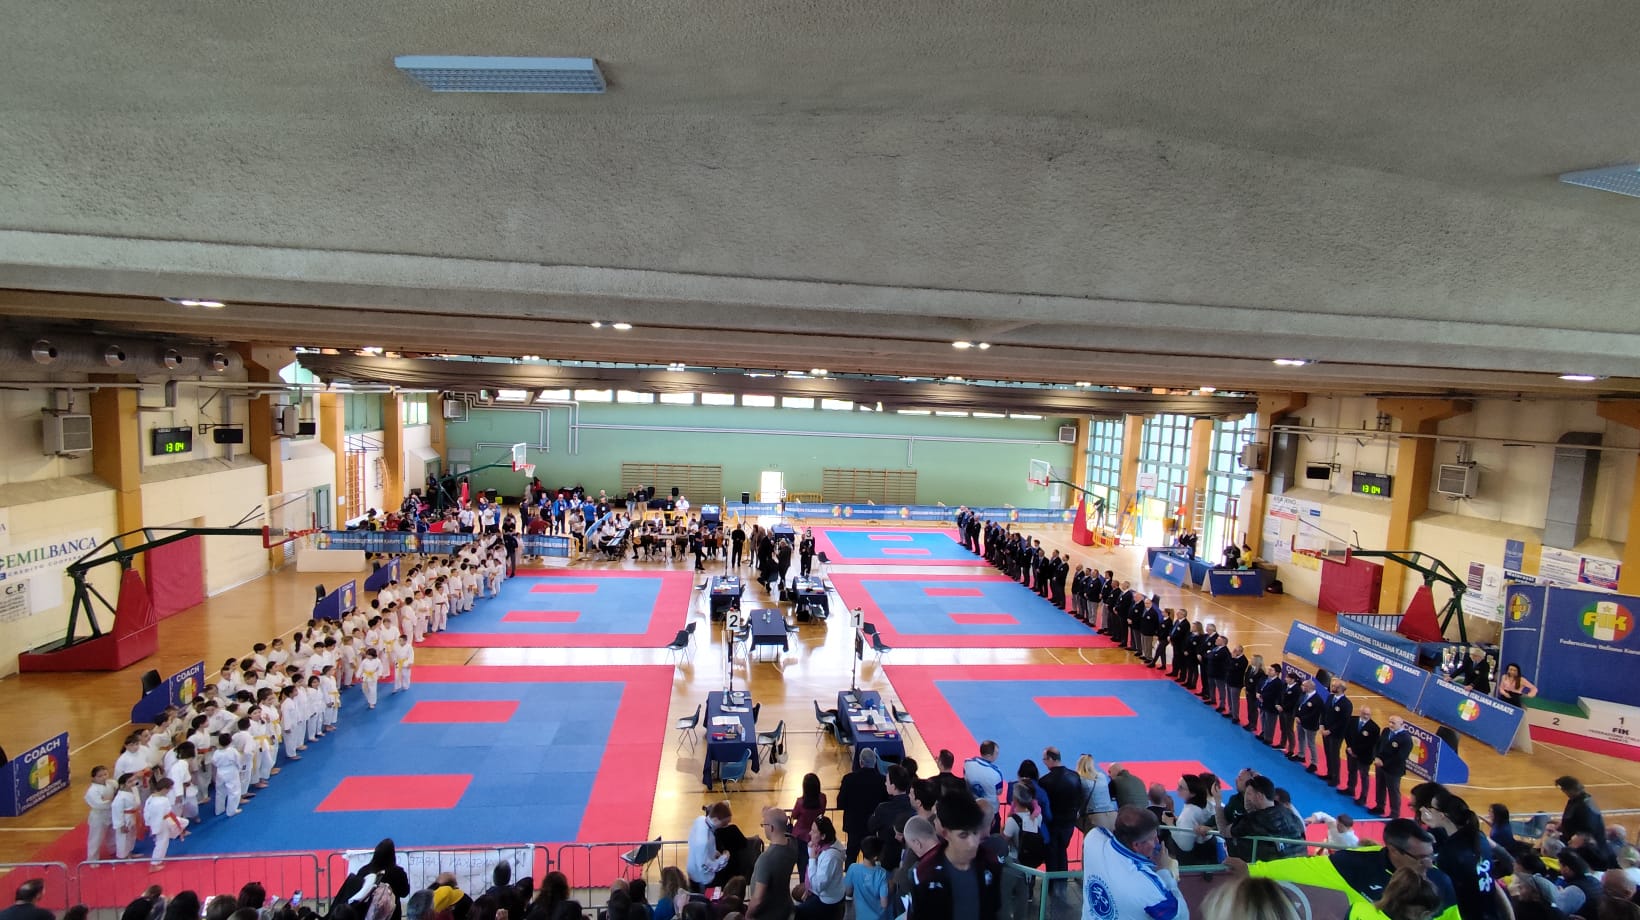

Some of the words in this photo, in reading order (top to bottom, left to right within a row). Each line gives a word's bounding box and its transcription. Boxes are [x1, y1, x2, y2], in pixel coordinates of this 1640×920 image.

[729, 615, 738, 627] 2
[854, 614, 861, 626] 1
[1372, 639, 1395, 653] ITALIANA
[1394, 646, 1417, 662] KARATE
[176, 665, 200, 682] COACH
[1552, 717, 1561, 726] 2
[1402, 723, 1433, 743] COACH
[24, 738, 61, 764] COACH
